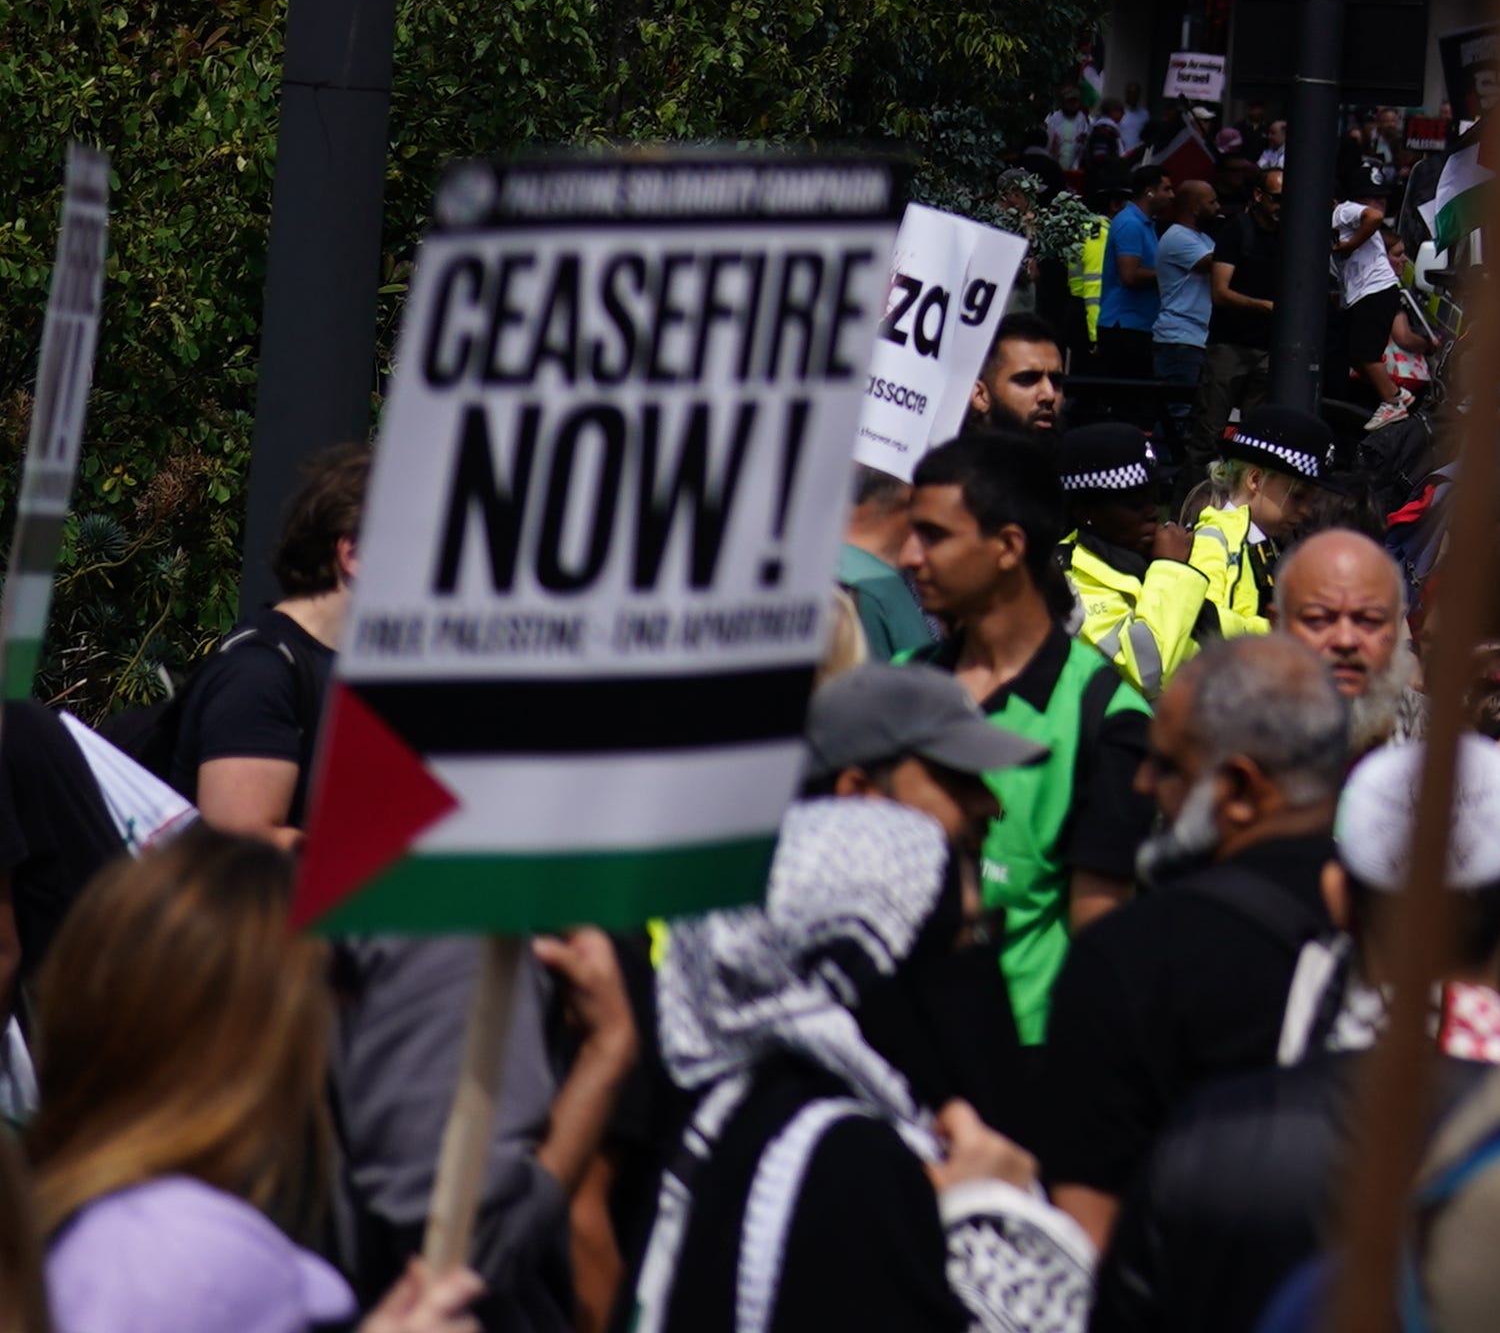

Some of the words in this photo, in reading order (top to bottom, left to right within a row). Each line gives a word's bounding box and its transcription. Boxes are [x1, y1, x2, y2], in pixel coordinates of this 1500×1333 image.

[422, 247, 878, 393] CEASEFIRE
[430, 398, 813, 598] NOW!
[433, 613, 584, 656] PALESTINE
